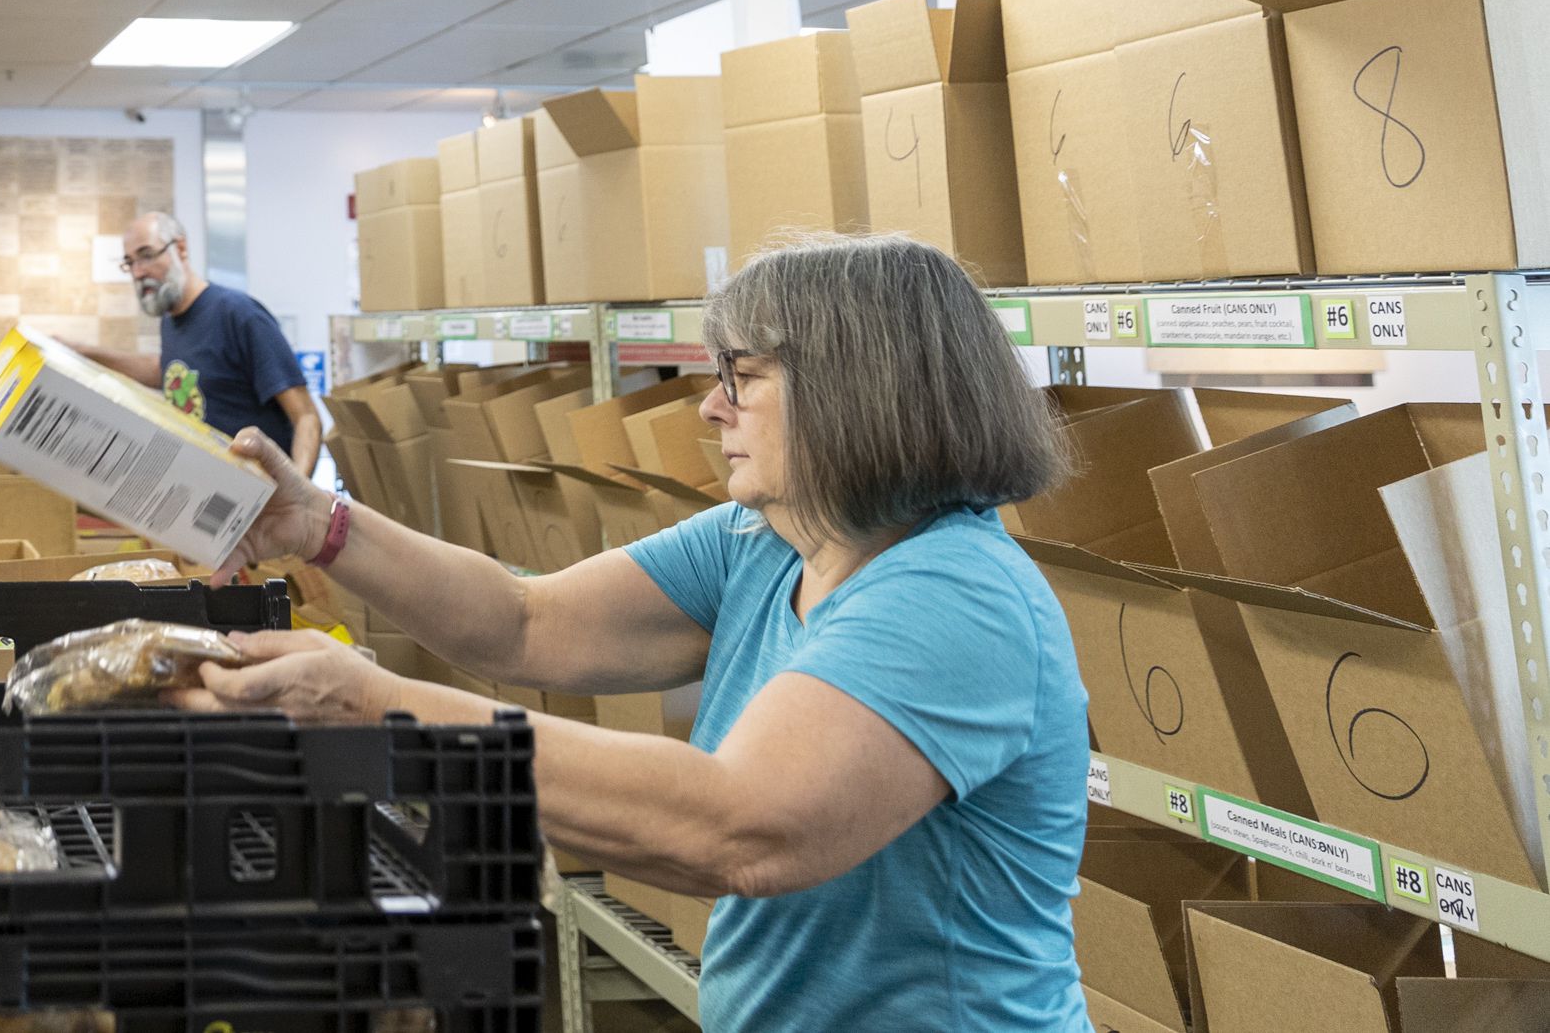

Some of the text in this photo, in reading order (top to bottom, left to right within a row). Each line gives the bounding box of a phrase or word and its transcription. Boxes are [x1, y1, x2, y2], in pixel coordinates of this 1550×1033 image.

[1167, 71, 1191, 163] 6
[1352, 45, 1426, 189] 8
[884, 106, 922, 208] 4
[1085, 302, 1108, 314] CANS
[1171, 302, 1277, 315] Canned Fruit (CANS ONLY)
[1326, 305, 1349, 327] #6
[1369, 301, 1402, 315] CANS
[1086, 321, 1109, 333] ONLY
[1117, 311, 1134, 329] #6
[1179, 319, 1210, 329] applesauce,
[1211, 319, 1236, 329] peaches,
[1237, 320, 1253, 329] pears,
[1254, 319, 1268, 328] fruit
[1268, 319, 1295, 328] cocktail,
[1372, 324, 1405, 338] ONLY
[1224, 331, 1252, 340] mandarin
[1252, 332, 1277, 341] oranges,
[1118, 601, 1184, 747] 6
[1325, 650, 1430, 801] 6
[1087, 767, 1108, 782] ANS
[1169, 791, 1188, 814] #8
[1226, 808, 1350, 863] Canned Meals (CANS ONLY)
[1311, 855, 1326, 867] pork
[1335, 862, 1356, 878] beans
[1396, 865, 1422, 894] #8
[1435, 872, 1473, 897] CANS
[1439, 898, 1475, 923] ONLY
